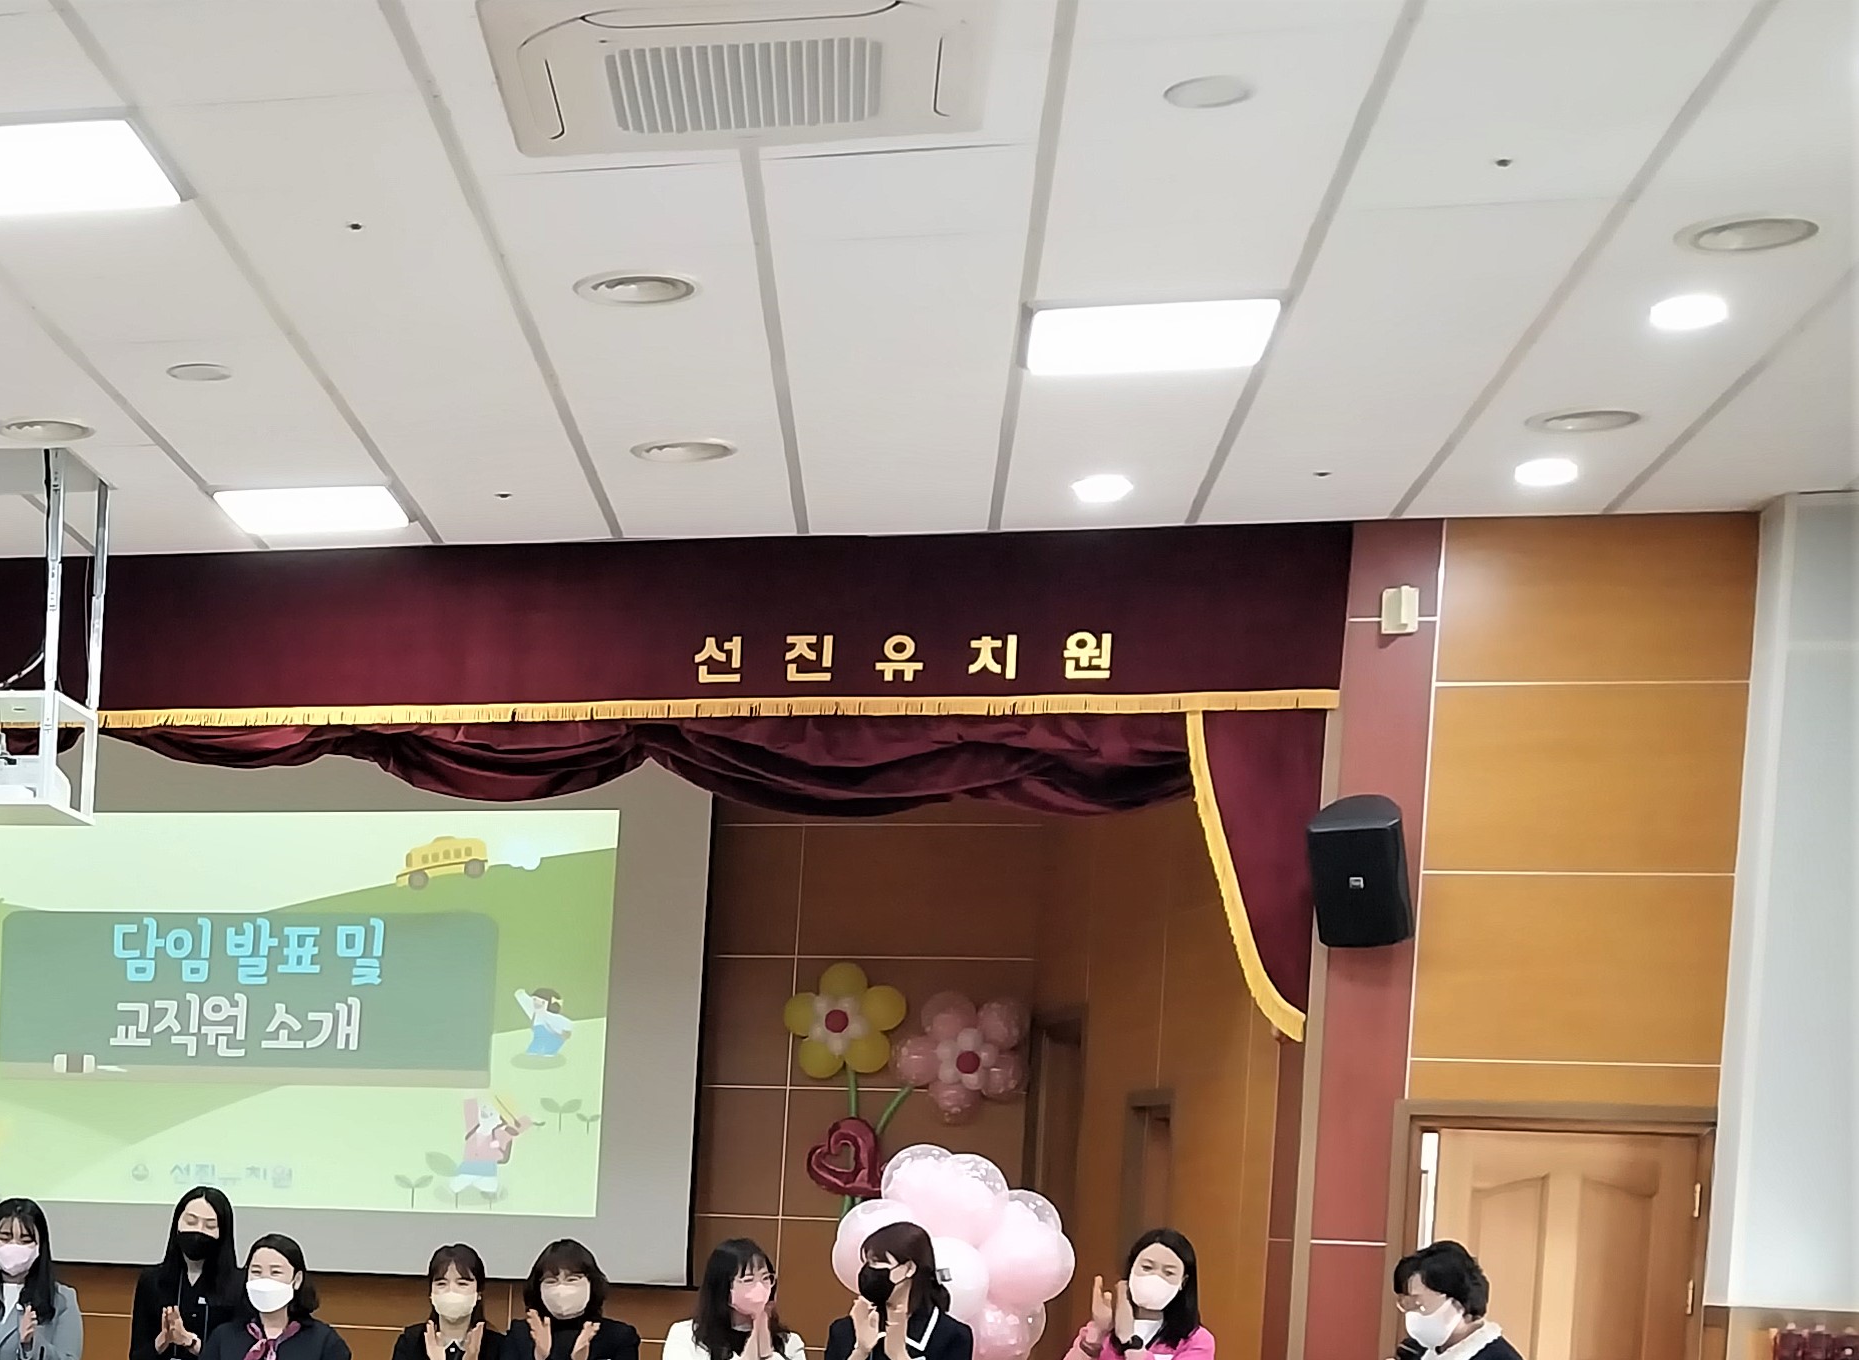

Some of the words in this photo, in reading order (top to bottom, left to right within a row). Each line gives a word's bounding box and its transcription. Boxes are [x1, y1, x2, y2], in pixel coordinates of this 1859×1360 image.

[694, 631, 1113, 684] 선진유치원
[113, 917, 212, 983] 담임
[226, 917, 322, 985] 발표
[336, 917, 385, 986] 및
[109, 992, 248, 1057] 교직원
[261, 996, 361, 1051] 소개
